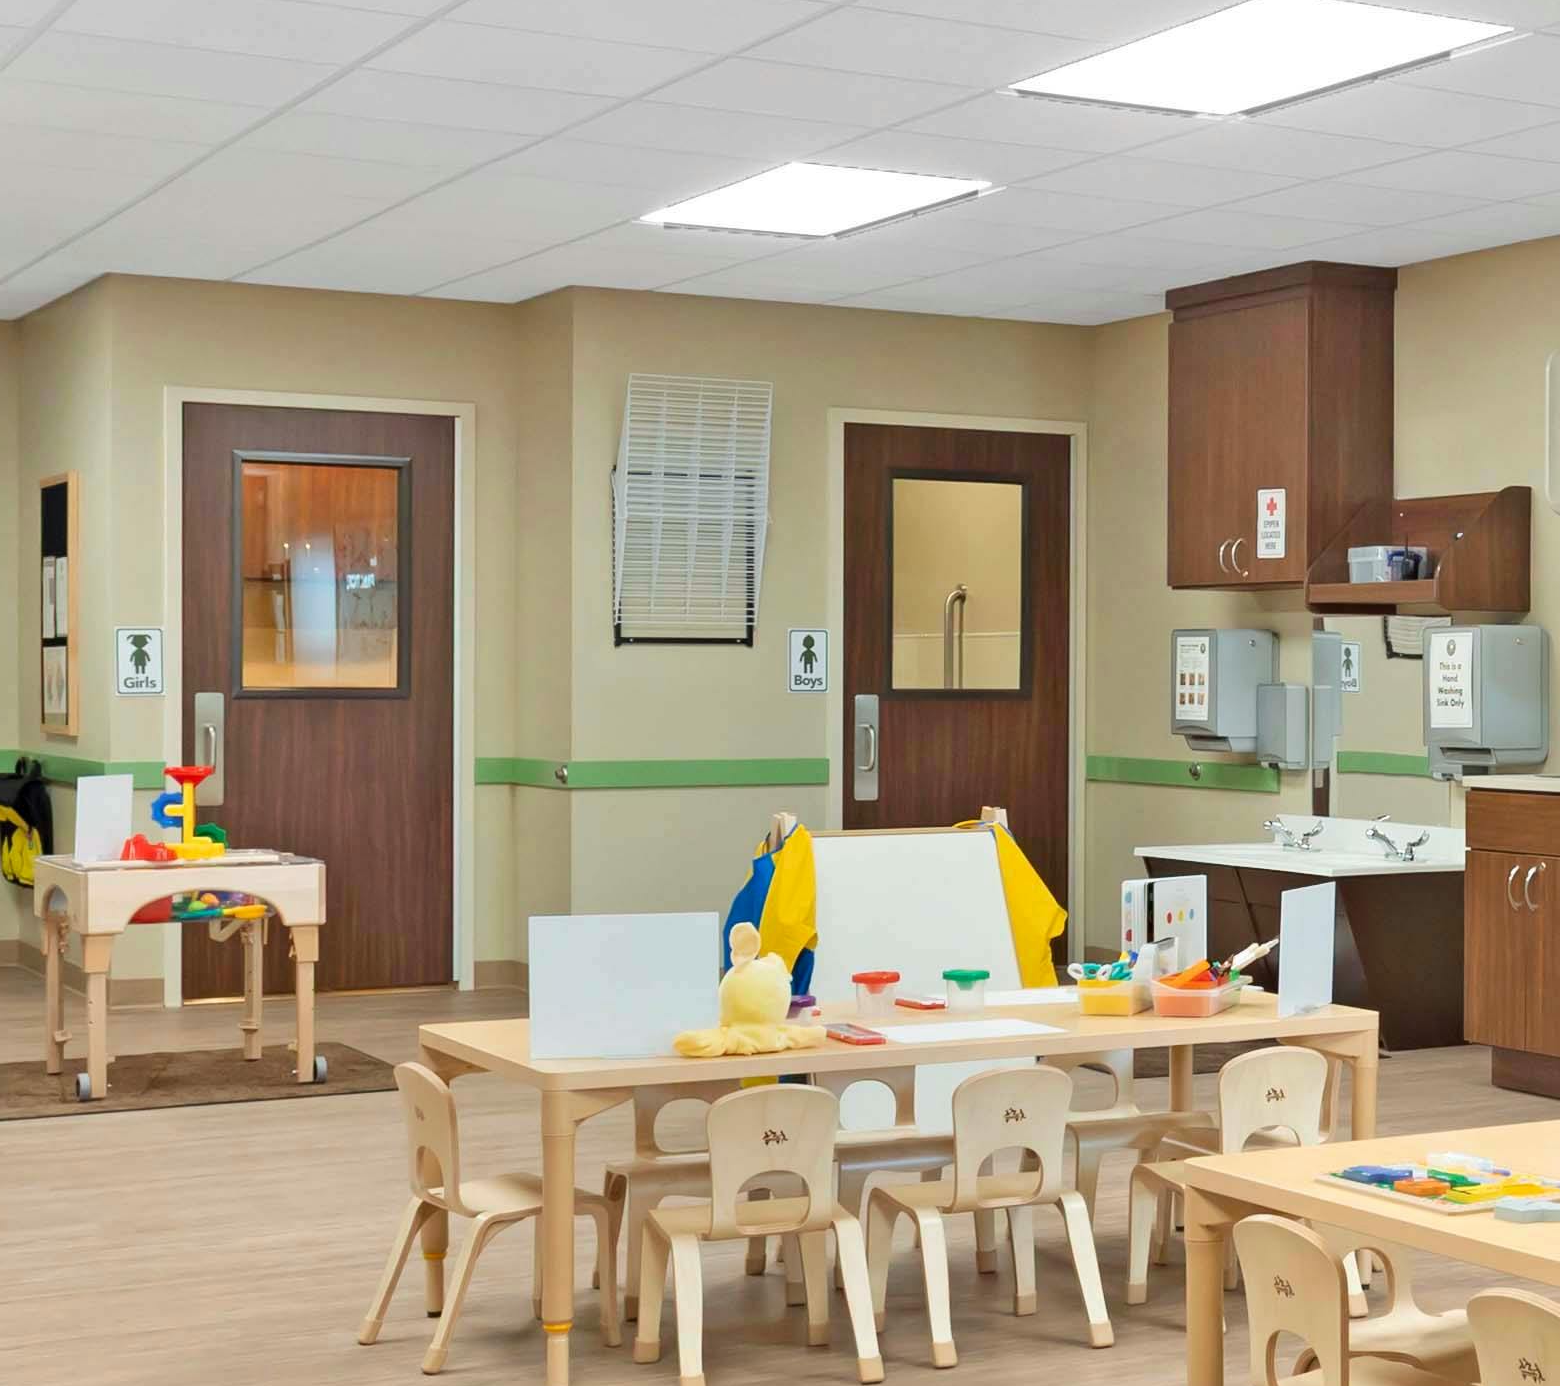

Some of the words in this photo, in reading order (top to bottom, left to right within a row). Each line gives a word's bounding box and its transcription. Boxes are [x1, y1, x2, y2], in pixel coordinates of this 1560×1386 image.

[1439, 662, 1450, 671] This
[123, 676, 157, 689] Girls
[794, 674, 824, 689] Boys
[1442, 674, 1459, 682] Hand
[1438, 687, 1464, 697] Washing
[1436, 699, 1449, 707] Sink
[1450, 698, 1465, 709] Only
